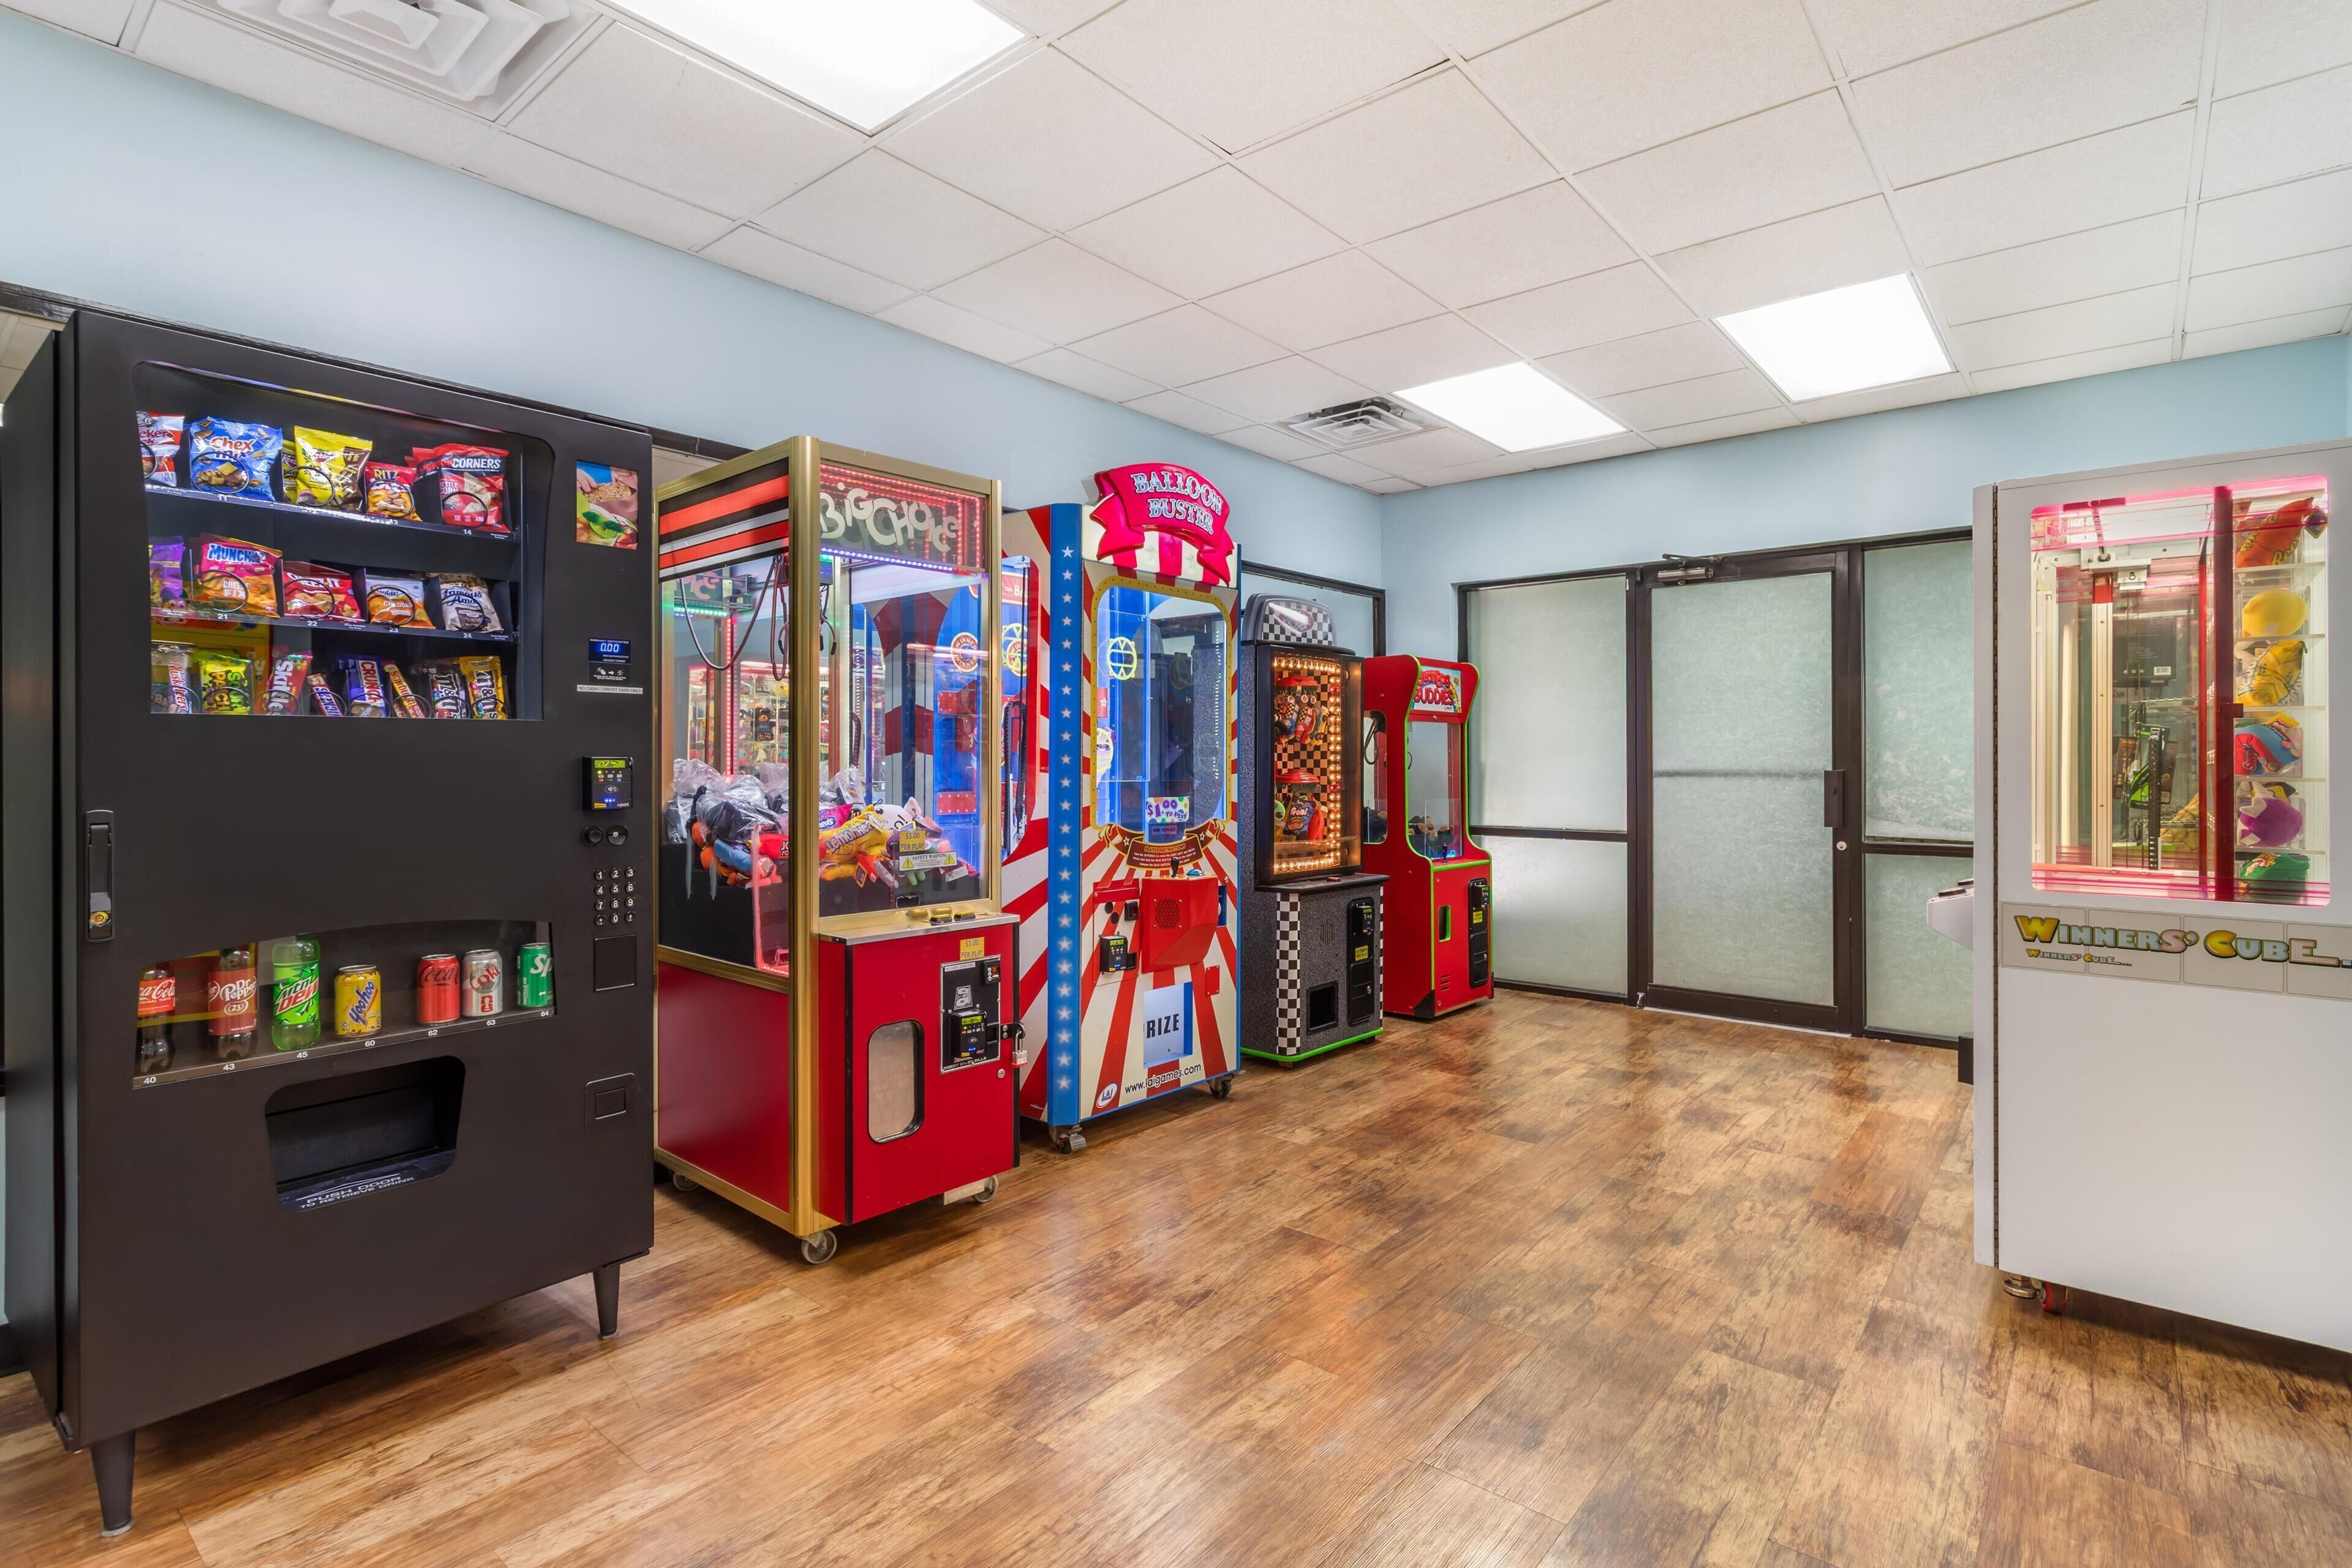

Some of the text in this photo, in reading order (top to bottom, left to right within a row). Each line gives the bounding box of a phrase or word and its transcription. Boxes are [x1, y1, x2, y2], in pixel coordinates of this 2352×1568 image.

[210, 436, 256, 451] Chex
[452, 458, 501, 469] CORNERS
[374, 469, 398, 480] RITZ
[1131, 471, 1223, 515] BALLOON
[1147, 499, 1213, 534] BUSTER
[224, 590, 246, 599] FIX
[447, 595, 478, 606] Amo
[600, 643, 619, 652] 0.00
[1414, 687, 1454, 706] BUDDIES
[1159, 843, 1186, 853] INSTRUCTIONS
[2014, 915, 2199, 953] WINNERS'
[236, 979, 251, 990] Dr
[469, 963, 501, 990] Coke
[225, 981, 256, 1001] Pepper
[1144, 1013, 1180, 1039] RIZE
[1125, 1063, 1202, 1094] www.laigames.com
[307, 1176, 401, 1203] PUSH DOOR
[319, 1186, 375, 1204] RETRIEVE
[379, 1177, 415, 1188] DRINK
